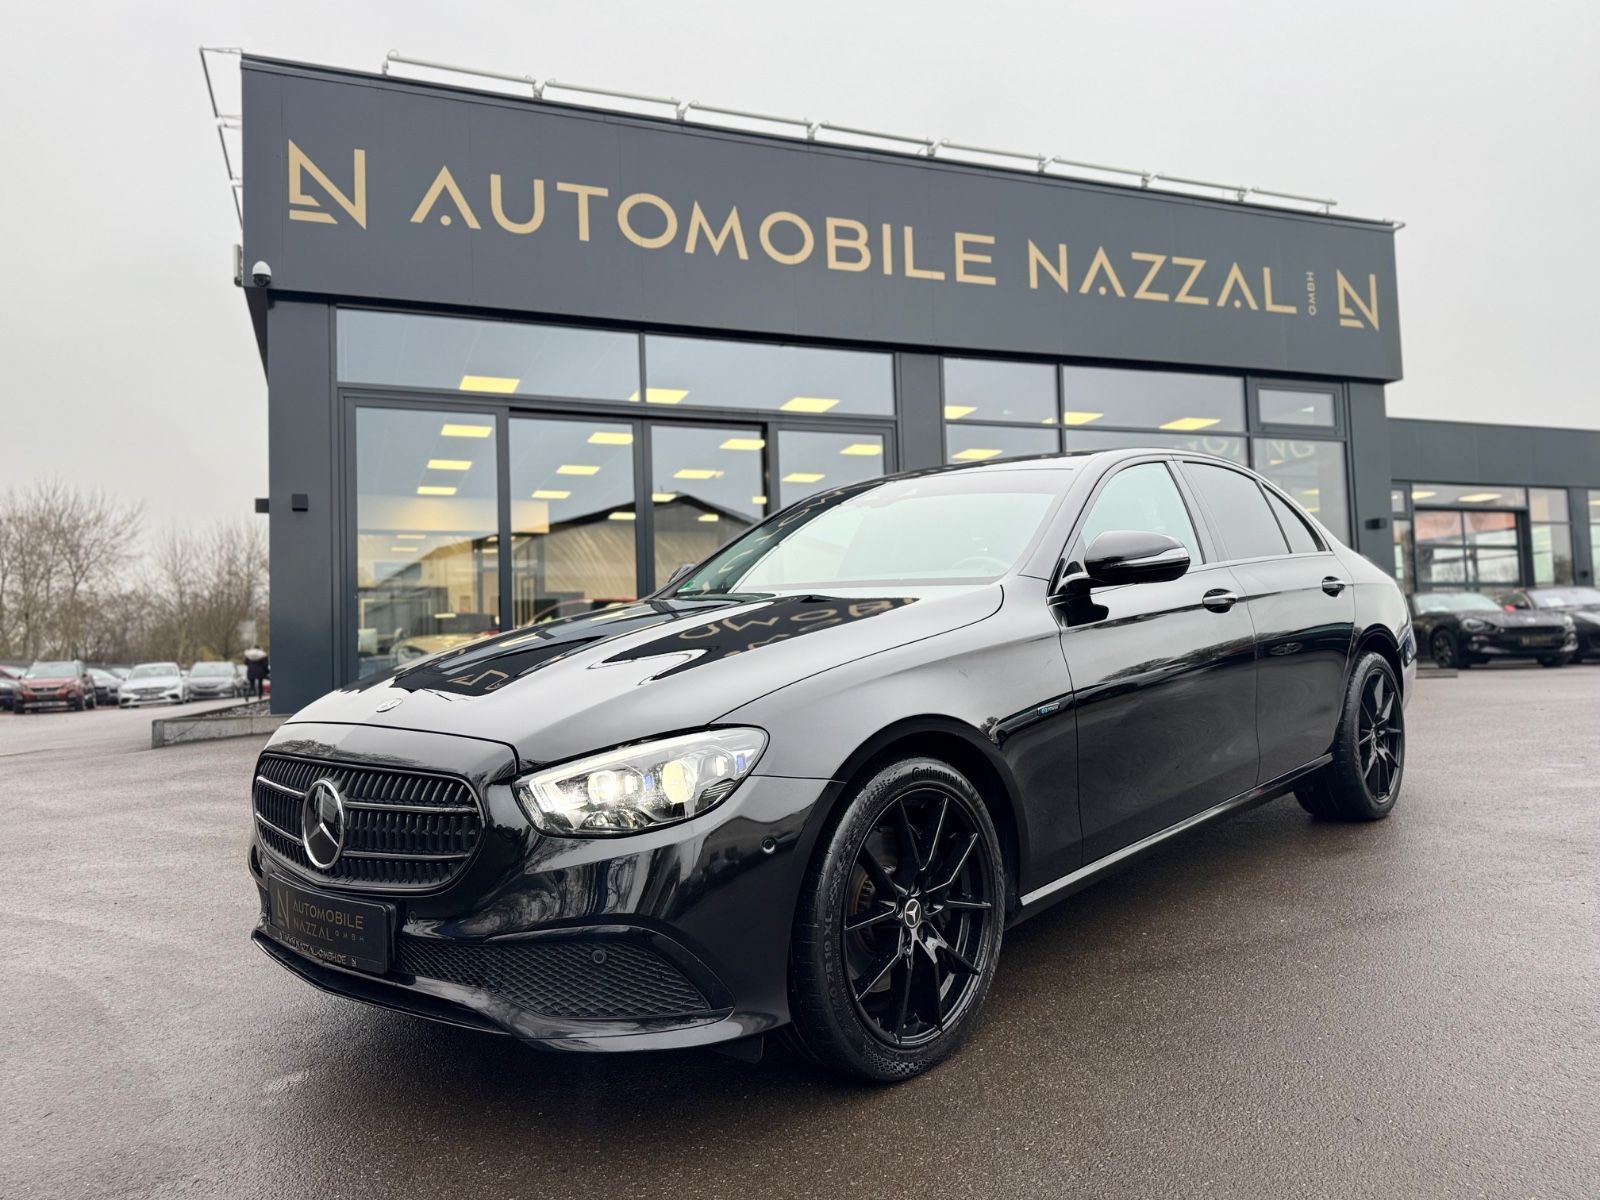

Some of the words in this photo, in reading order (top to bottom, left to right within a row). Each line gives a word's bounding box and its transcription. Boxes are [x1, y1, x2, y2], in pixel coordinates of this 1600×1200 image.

[410, 165, 997, 287] AUTOMOBILE
[1027, 239, 1298, 315] NAZZAL
[911, 766, 959, 788] Continental
[292, 900, 365, 930] AUTOMOBILE
[292, 918, 334, 942] NAZZAL
